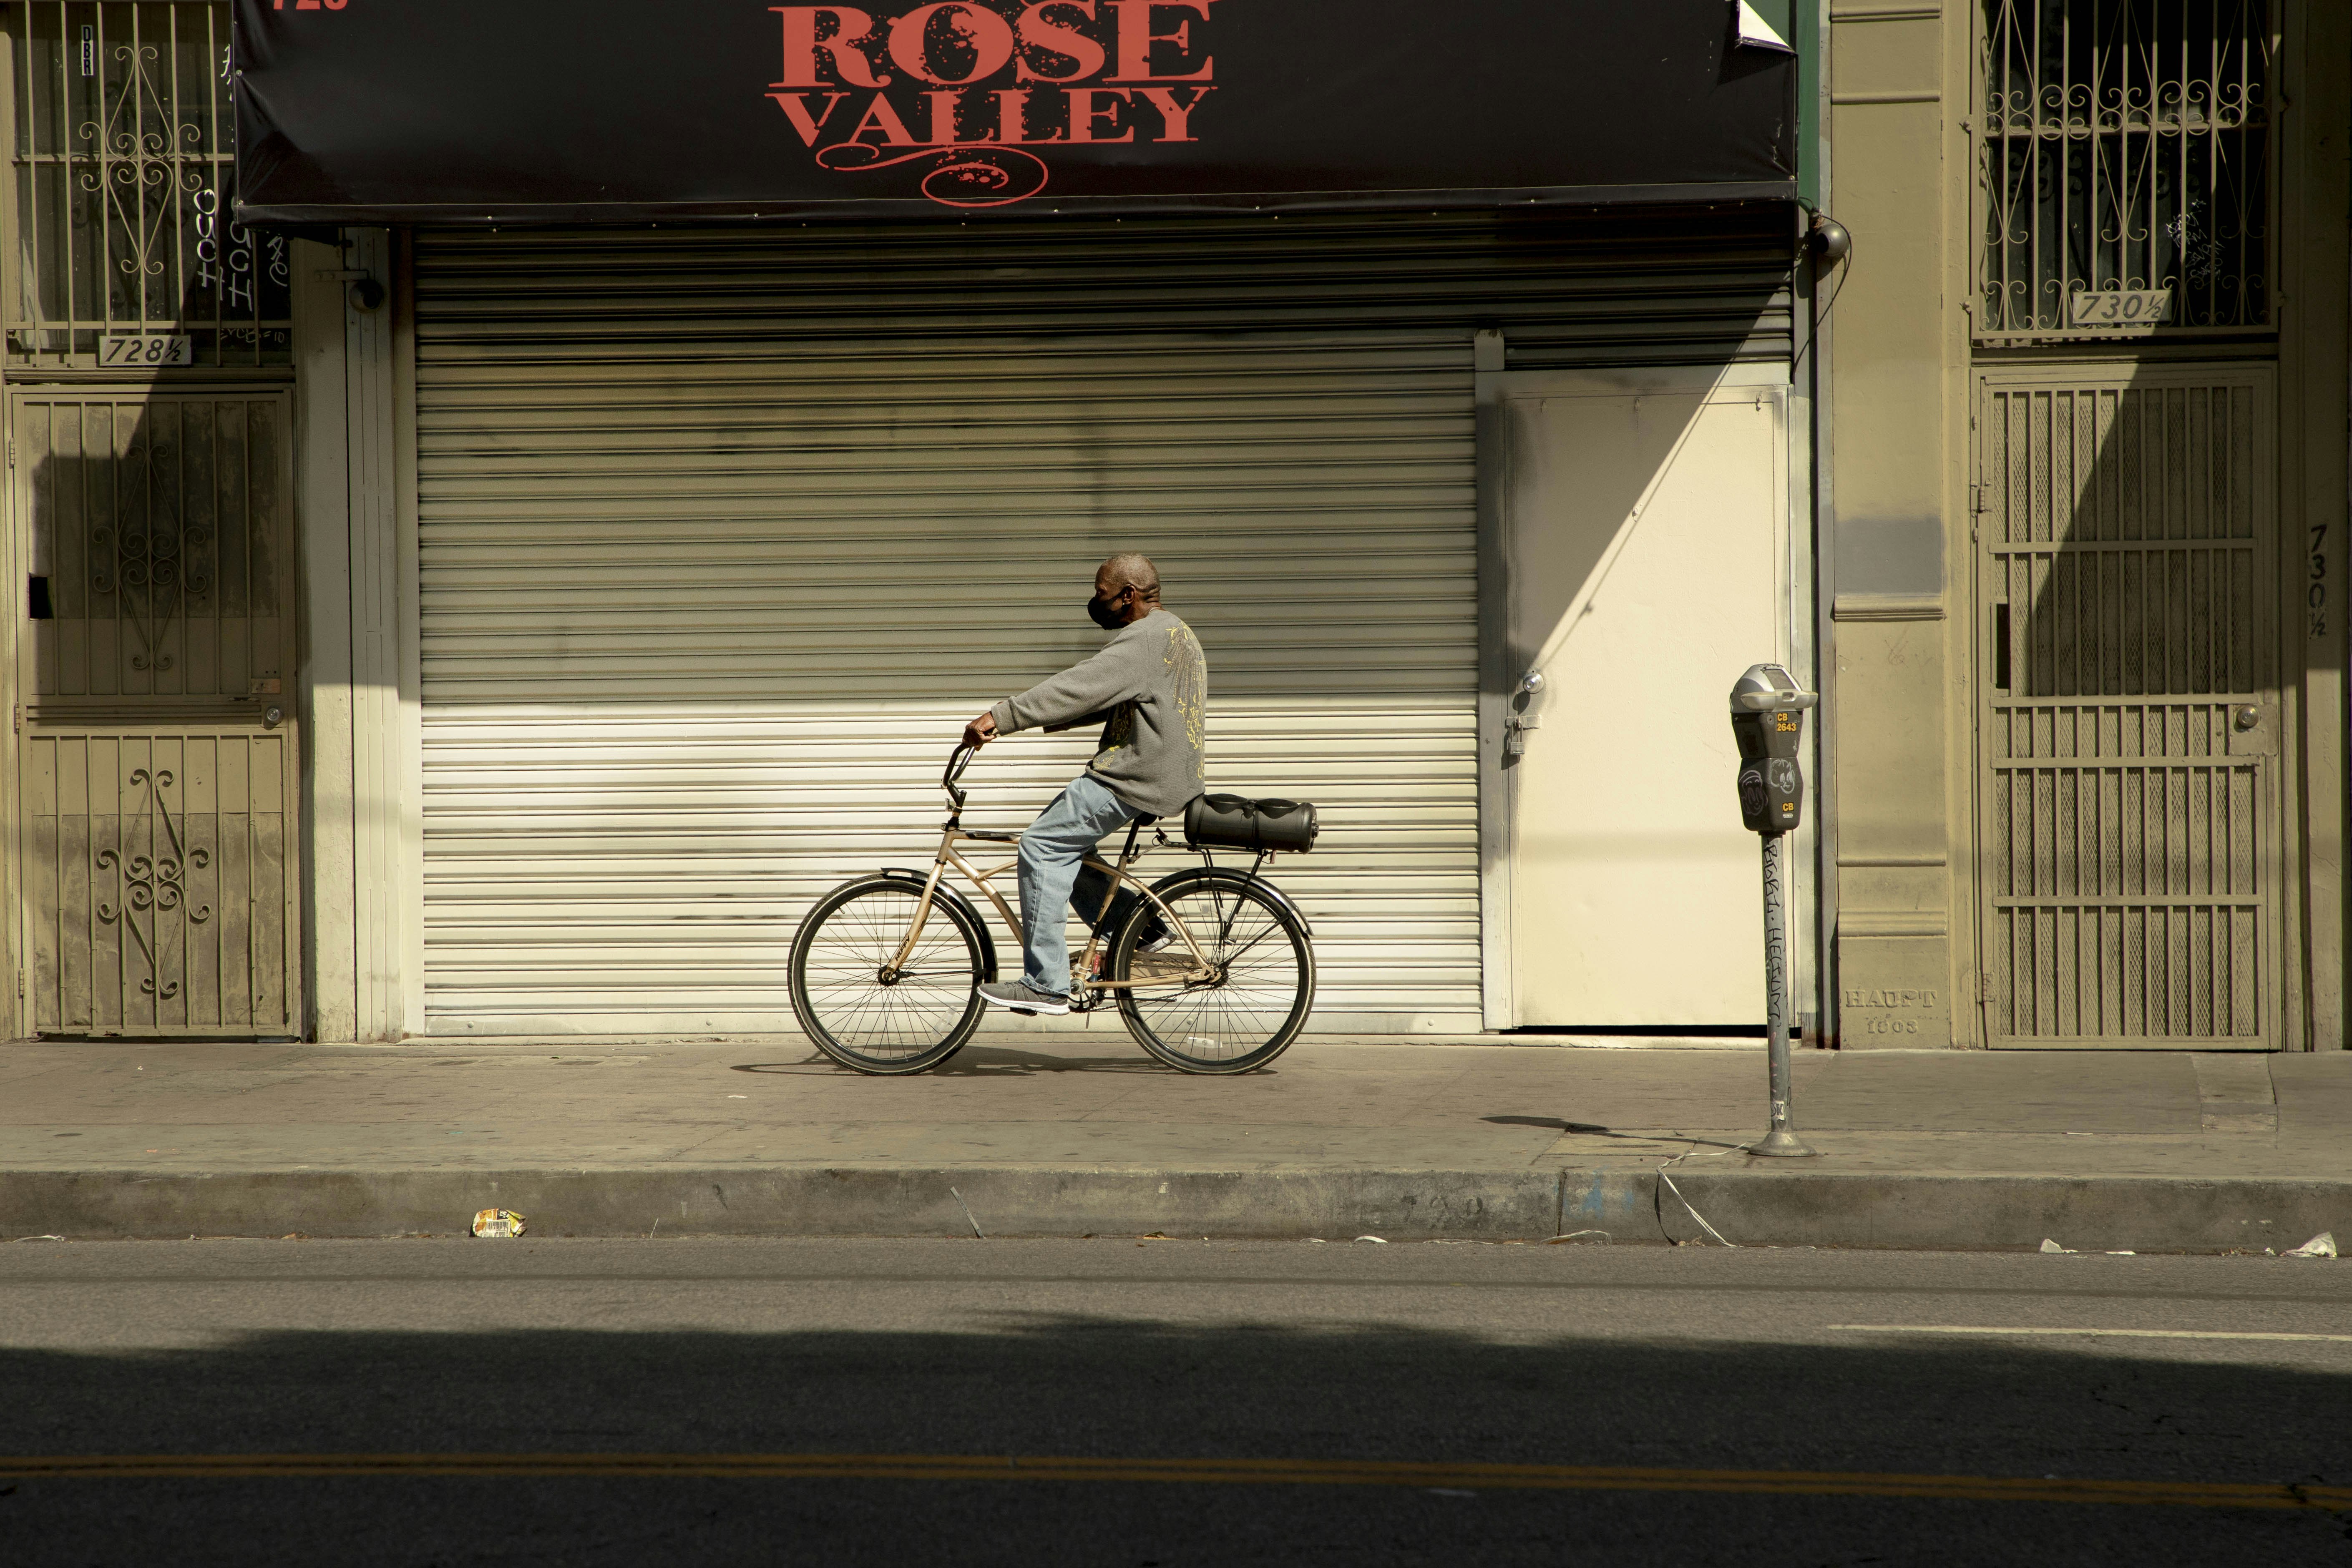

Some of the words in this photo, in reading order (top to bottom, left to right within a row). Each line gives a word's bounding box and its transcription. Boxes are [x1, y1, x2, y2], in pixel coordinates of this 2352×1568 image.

[768, 0, 1213, 88] ROSE
[764, 86, 1218, 147] VALLEY
[228, 196, 252, 312] UCH
[1777, 713, 1788, 721] CB
[1777, 723, 1796, 731] 2643
[1782, 802, 1794, 812] CB
[895, 935, 910, 961] HUFFY
[1846, 989, 1937, 1008] HAUPT
